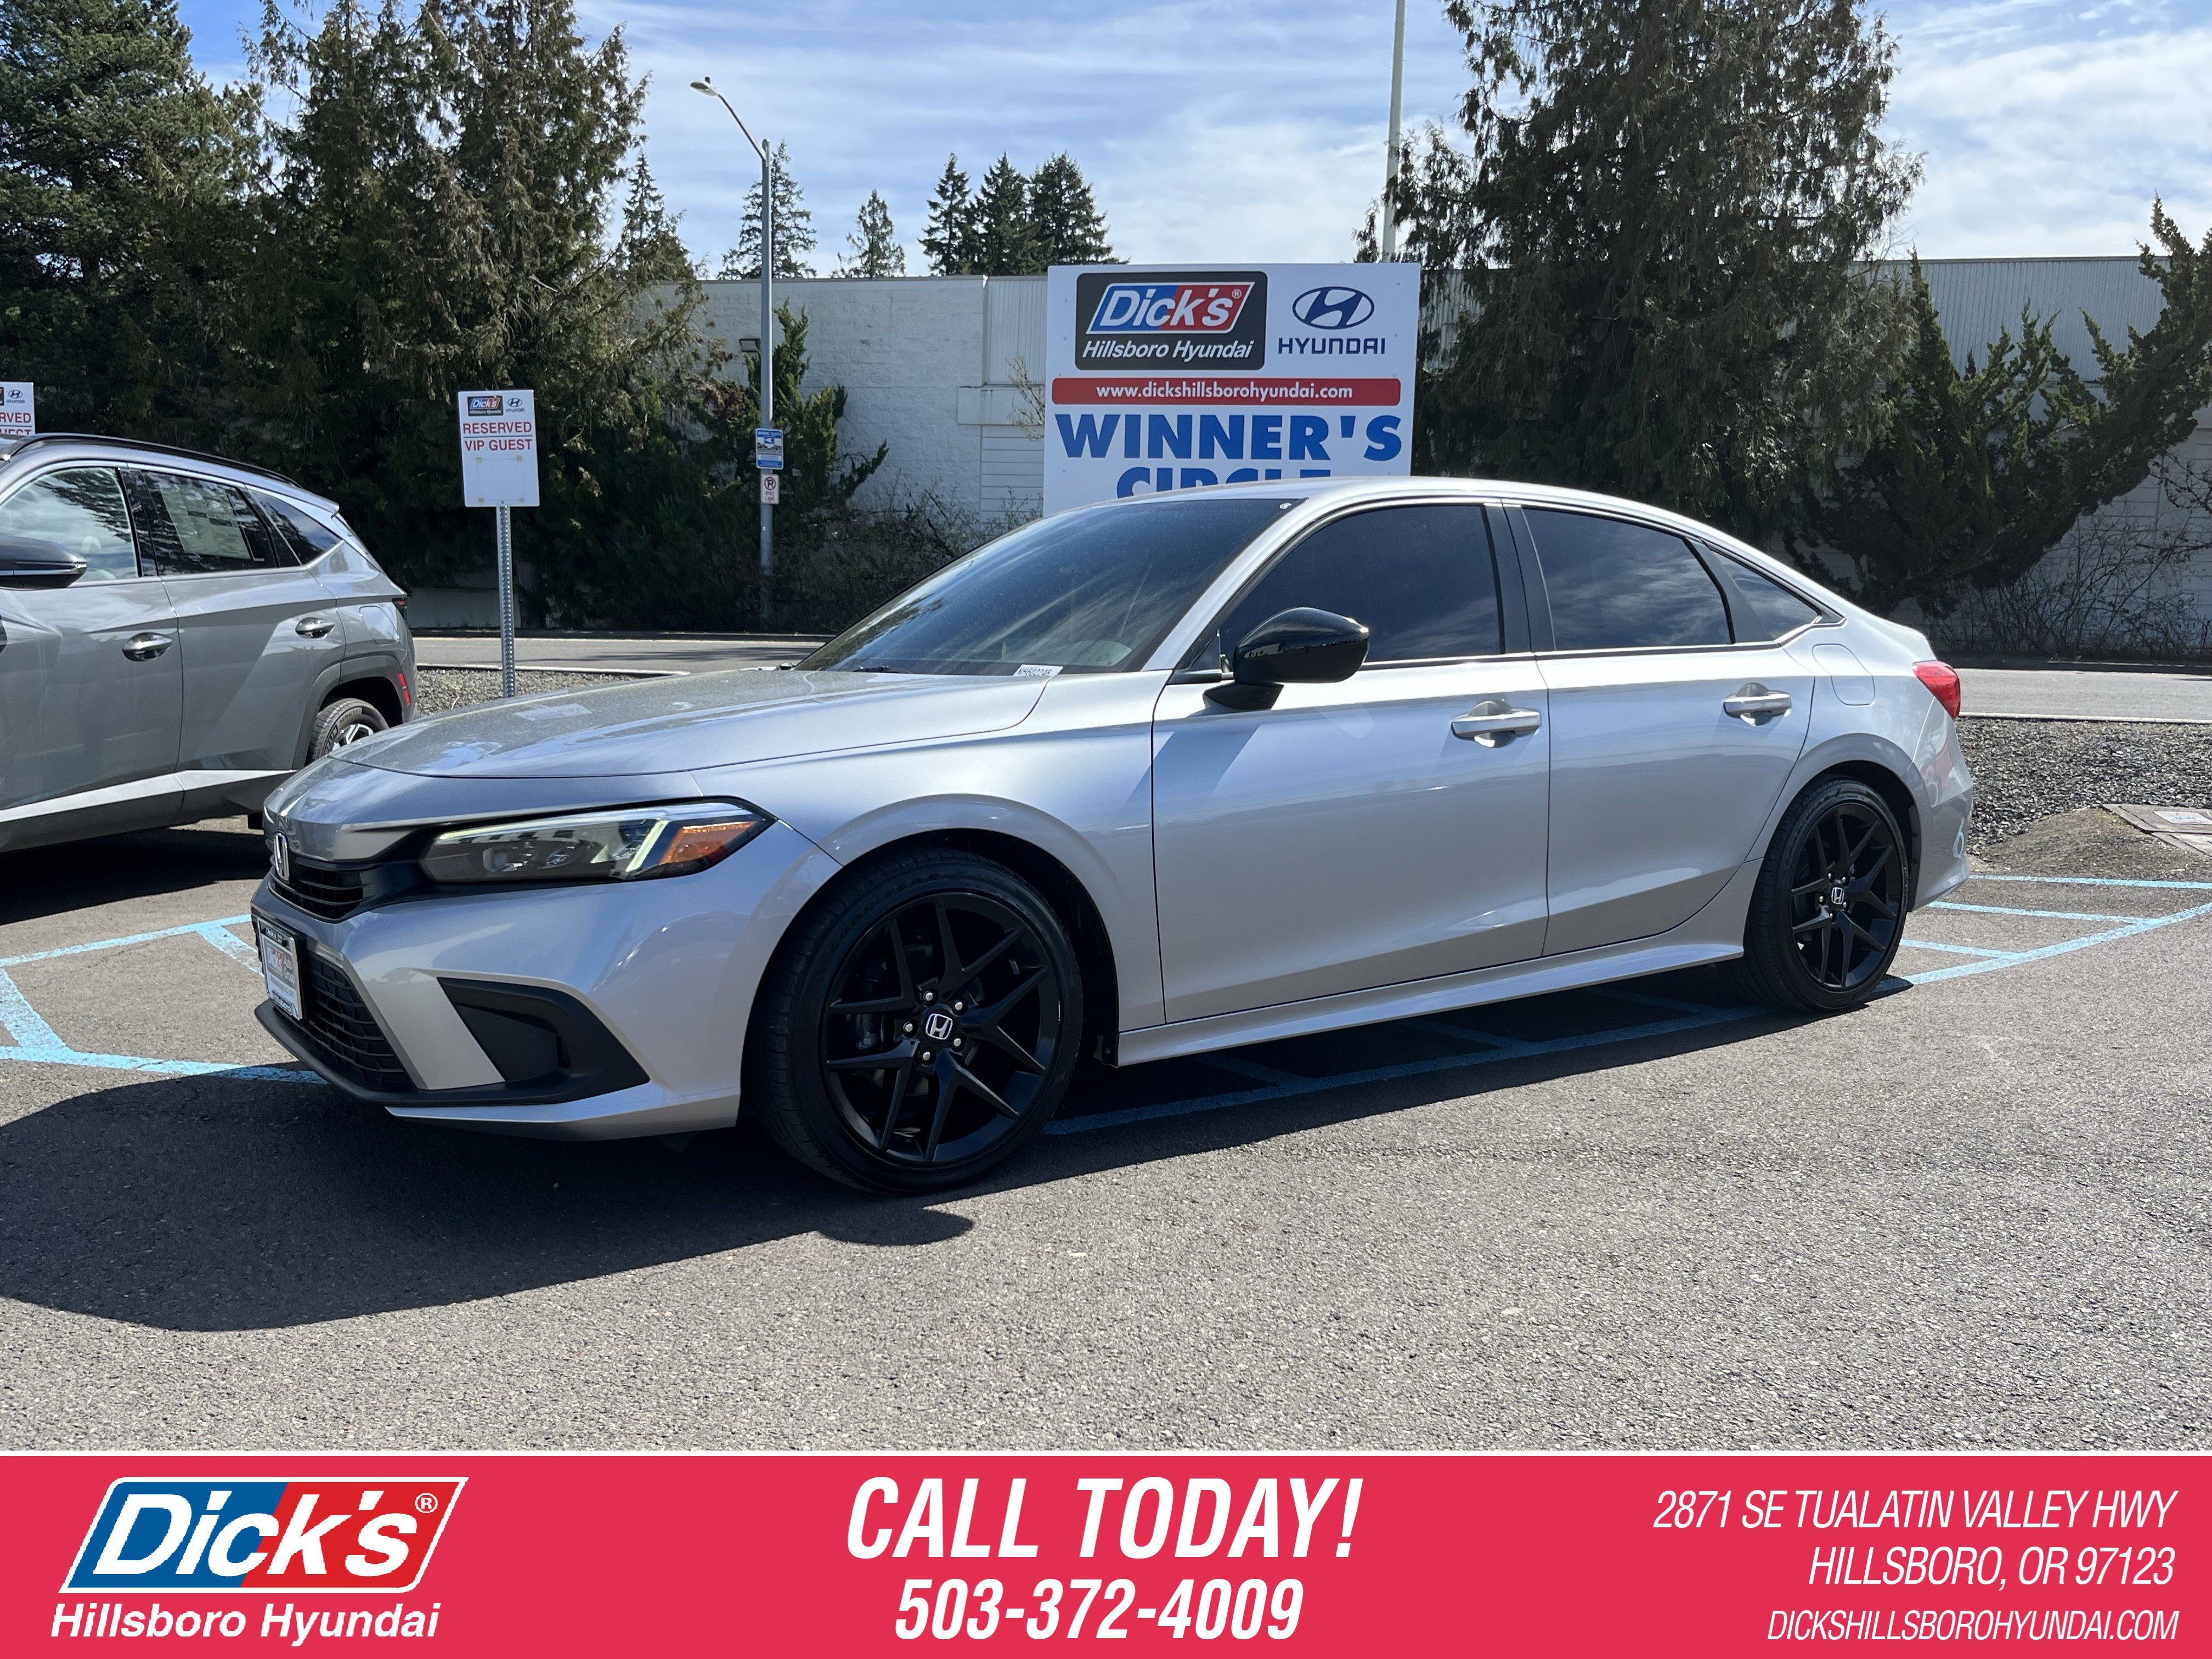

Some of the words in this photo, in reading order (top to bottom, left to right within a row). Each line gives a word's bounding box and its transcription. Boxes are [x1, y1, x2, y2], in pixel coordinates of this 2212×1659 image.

[1100, 288, 1233, 326] Dick's
[1082, 340, 1169, 358] Hillsboro
[1172, 340, 1254, 363] Hyundai
[1278, 337, 1386, 355] HYUNDAI
[1096, 381, 1353, 403] www.dickshillsborohyundai.com
[472, 398, 498, 408] Dick's
[463, 421, 532, 434] RESERVED
[465, 439, 484, 451] VIP
[489, 438, 532, 451] GUEST
[1054, 414, 1403, 462] WINNER'S
